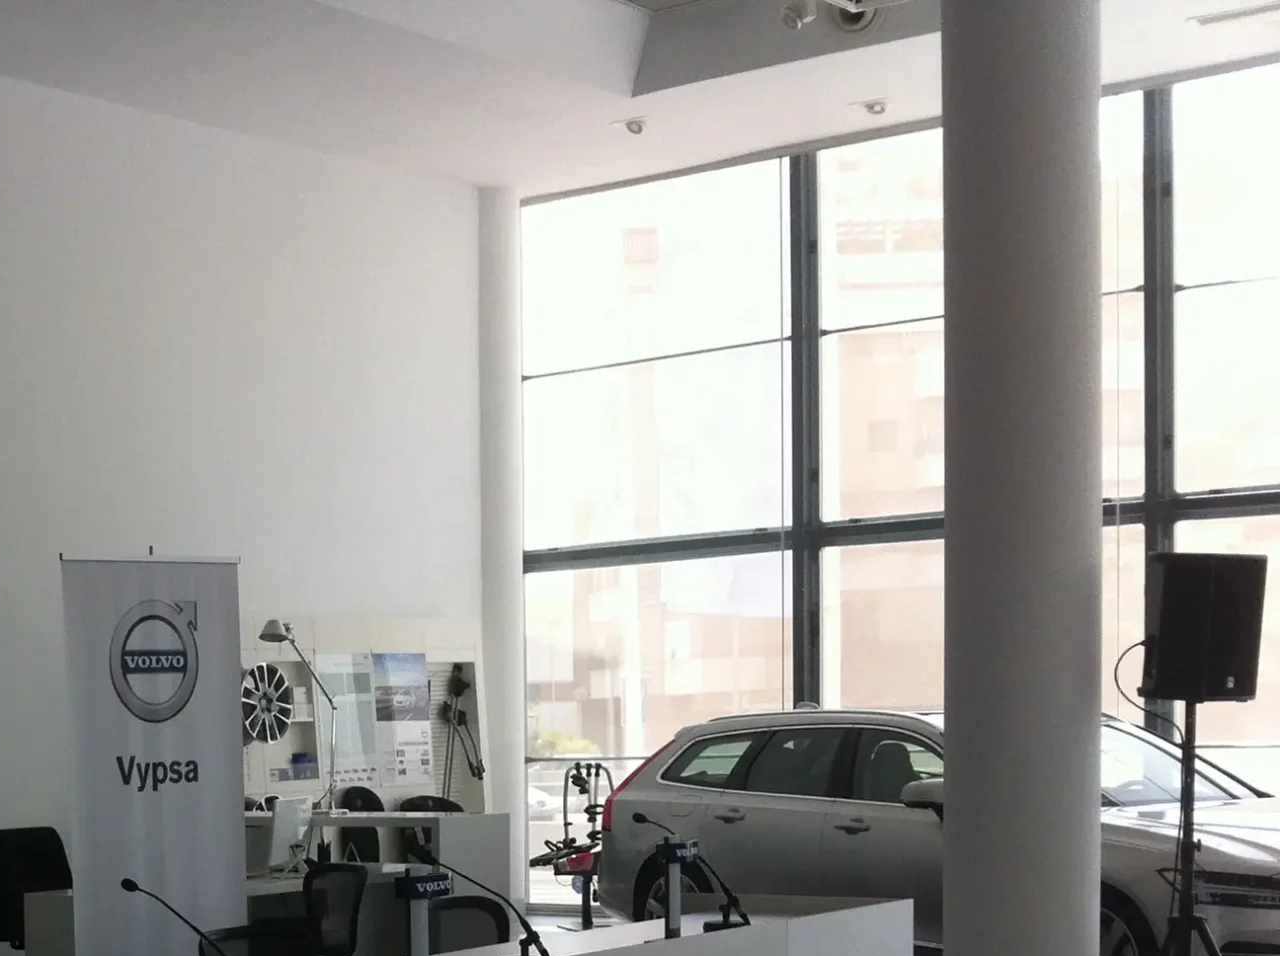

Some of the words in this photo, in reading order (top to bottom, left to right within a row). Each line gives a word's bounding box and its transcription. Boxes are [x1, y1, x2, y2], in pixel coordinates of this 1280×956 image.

[124, 655, 185, 669] VOLVO
[116, 755, 199, 793] Vypsa
[416, 880, 452, 892] VOLVO
